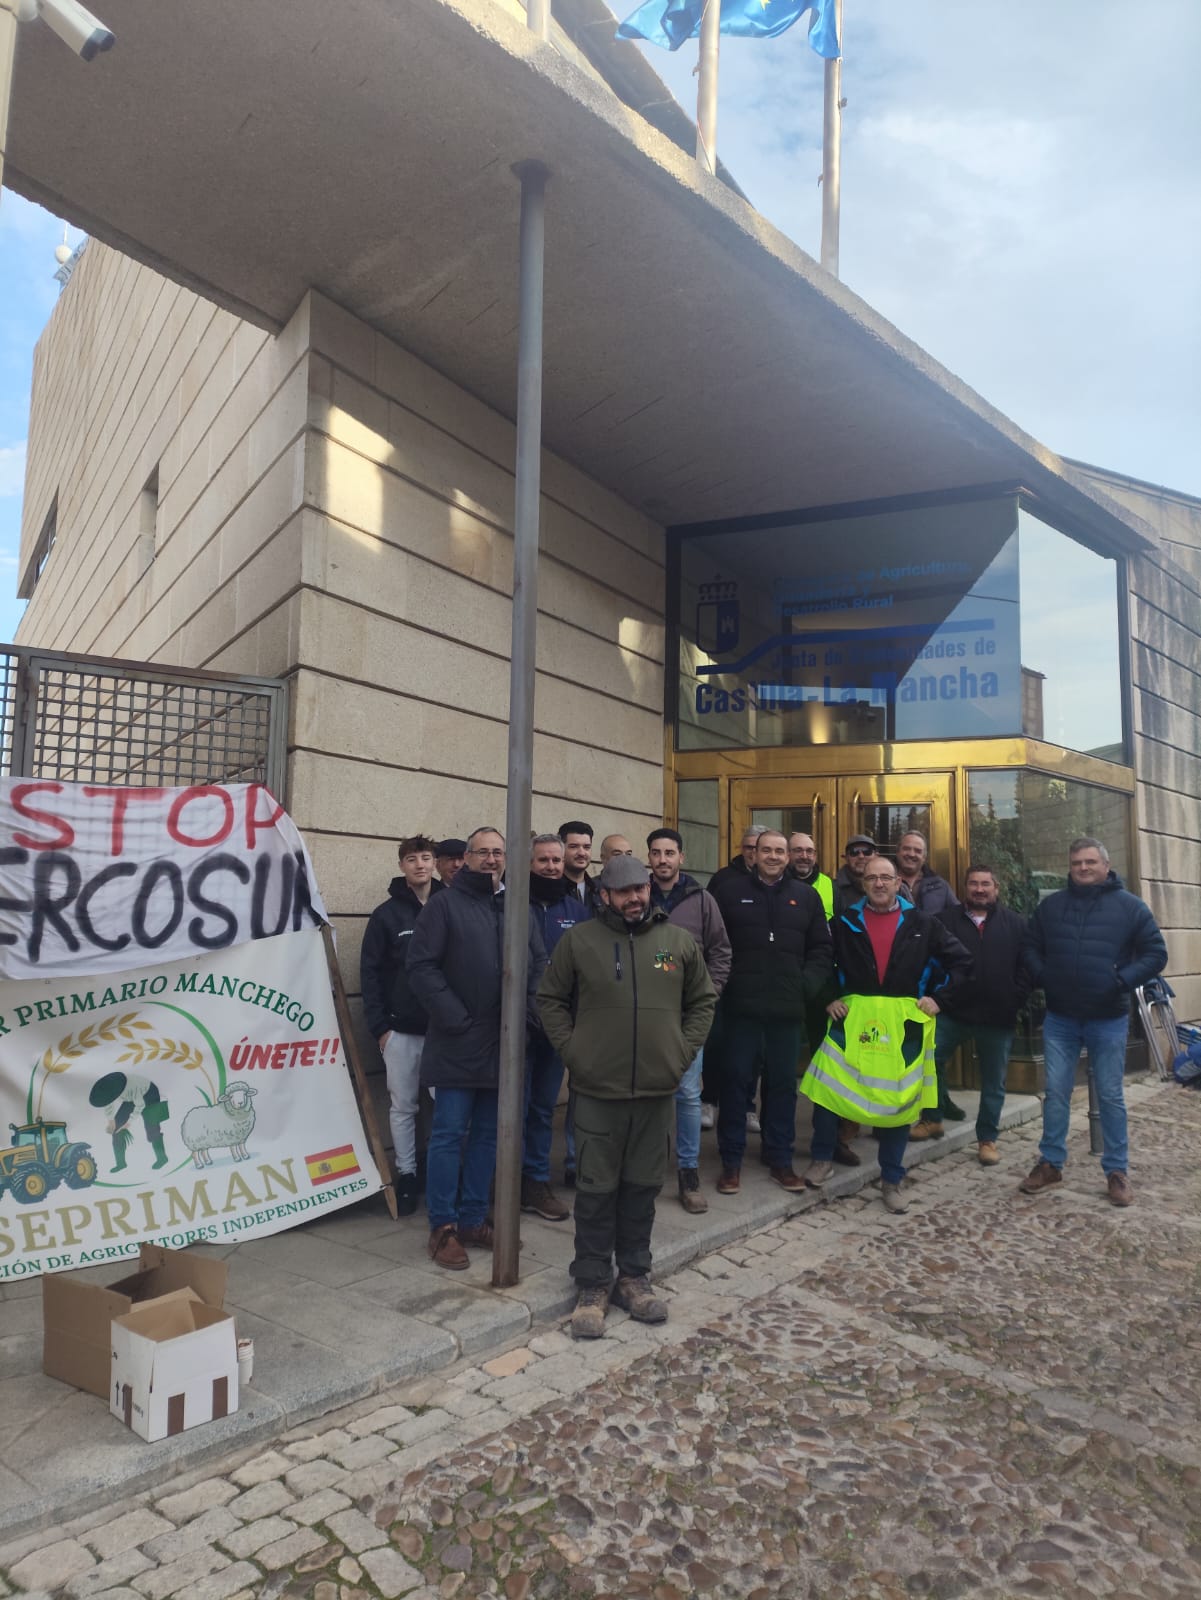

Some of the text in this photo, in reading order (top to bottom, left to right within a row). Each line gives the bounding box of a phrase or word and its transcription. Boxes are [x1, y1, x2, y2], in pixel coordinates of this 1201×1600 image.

[853, 594, 894, 609] Rural
[975, 637, 996, 655] de
[871, 666, 998, 704] Mancha
[10, 782, 285, 856] STOP
[13, 976, 168, 1027] PRIMARIO
[174, 972, 314, 1032] MANCHEGO
[229, 1036, 340, 1071] ÚNETE!!
[47, 1254, 73, 1269] DE
[223, 1178, 368, 1234] INDEPENDIENTES
